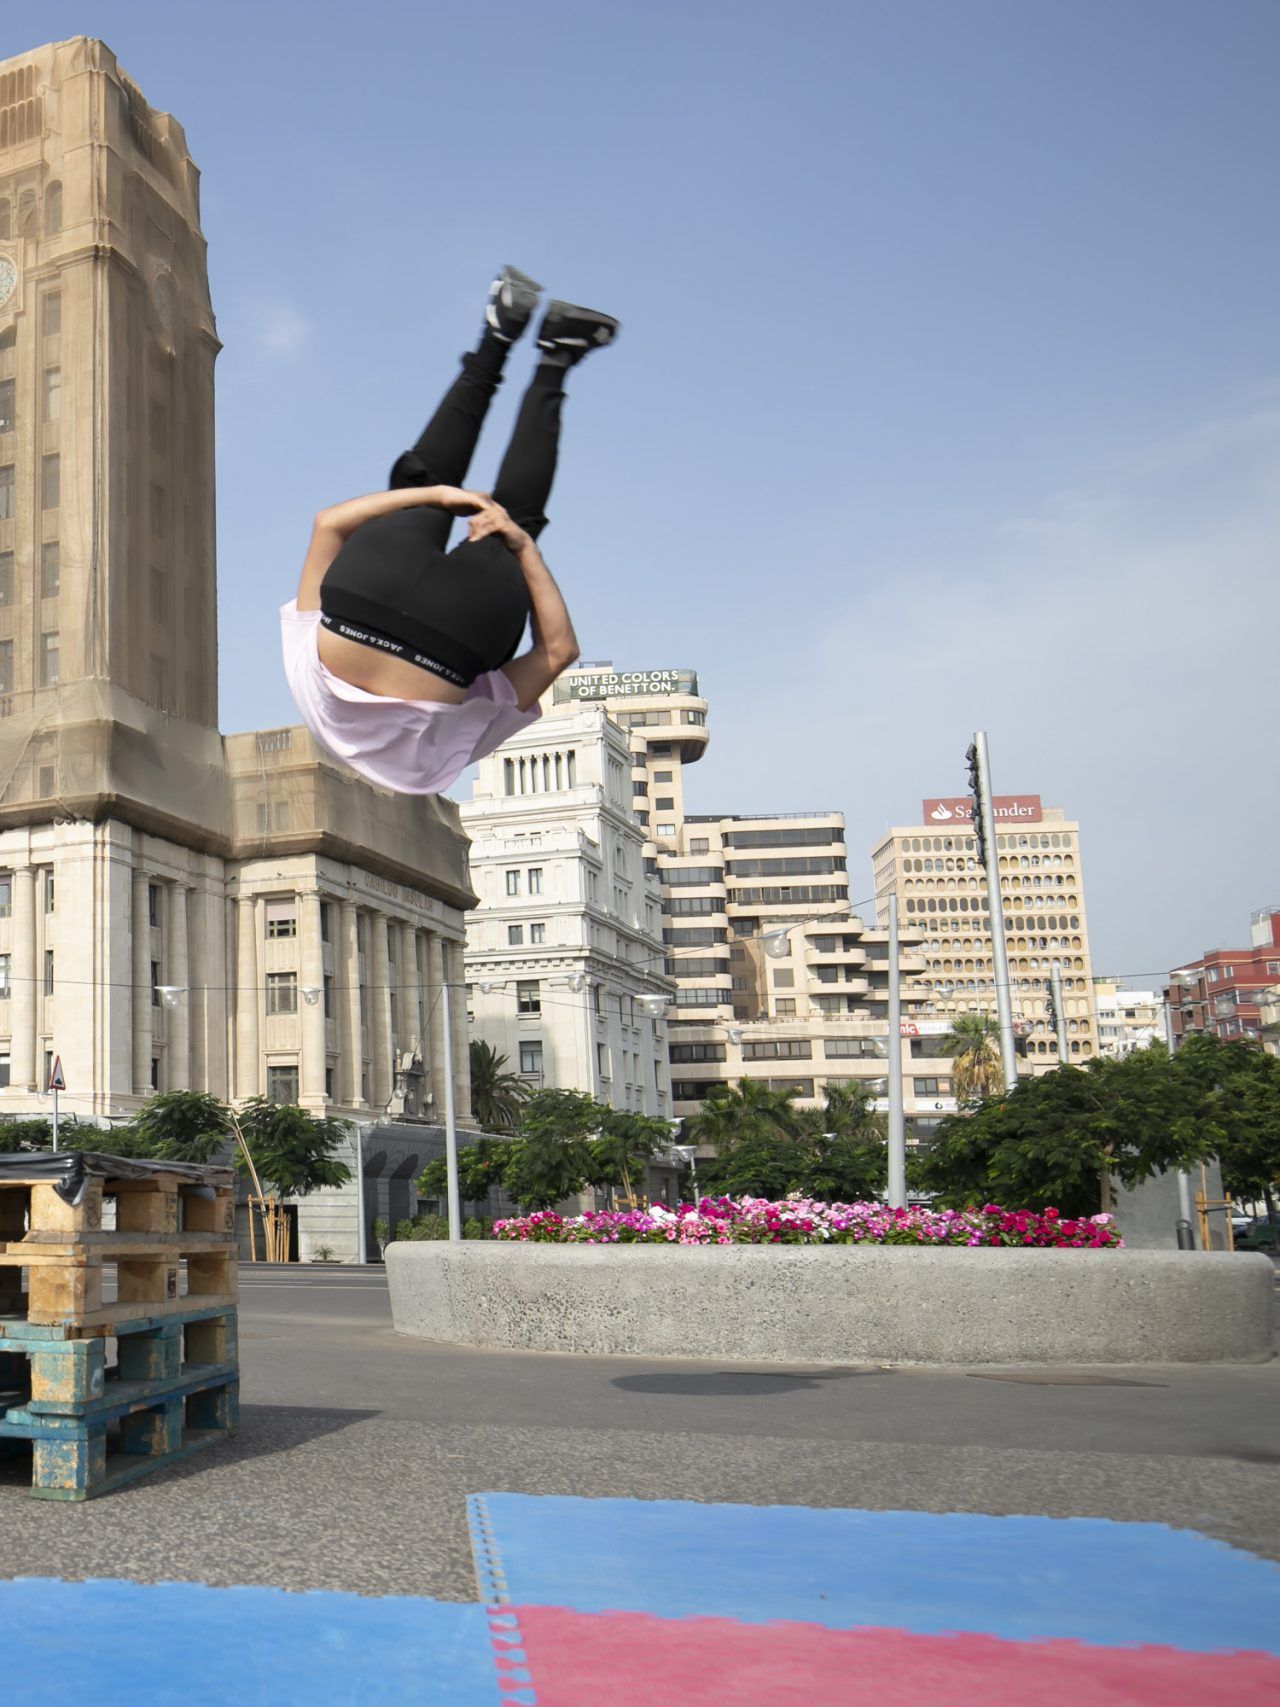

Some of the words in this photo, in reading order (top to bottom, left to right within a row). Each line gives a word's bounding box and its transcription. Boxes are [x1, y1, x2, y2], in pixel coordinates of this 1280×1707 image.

[340, 624, 368, 641] JONES
[377, 640, 403, 653] JACK
[414, 654, 444, 672] JONES
[570, 674, 618, 687] UNITED
[622, 670, 678, 683] COLORS
[578, 686, 597, 697] OF
